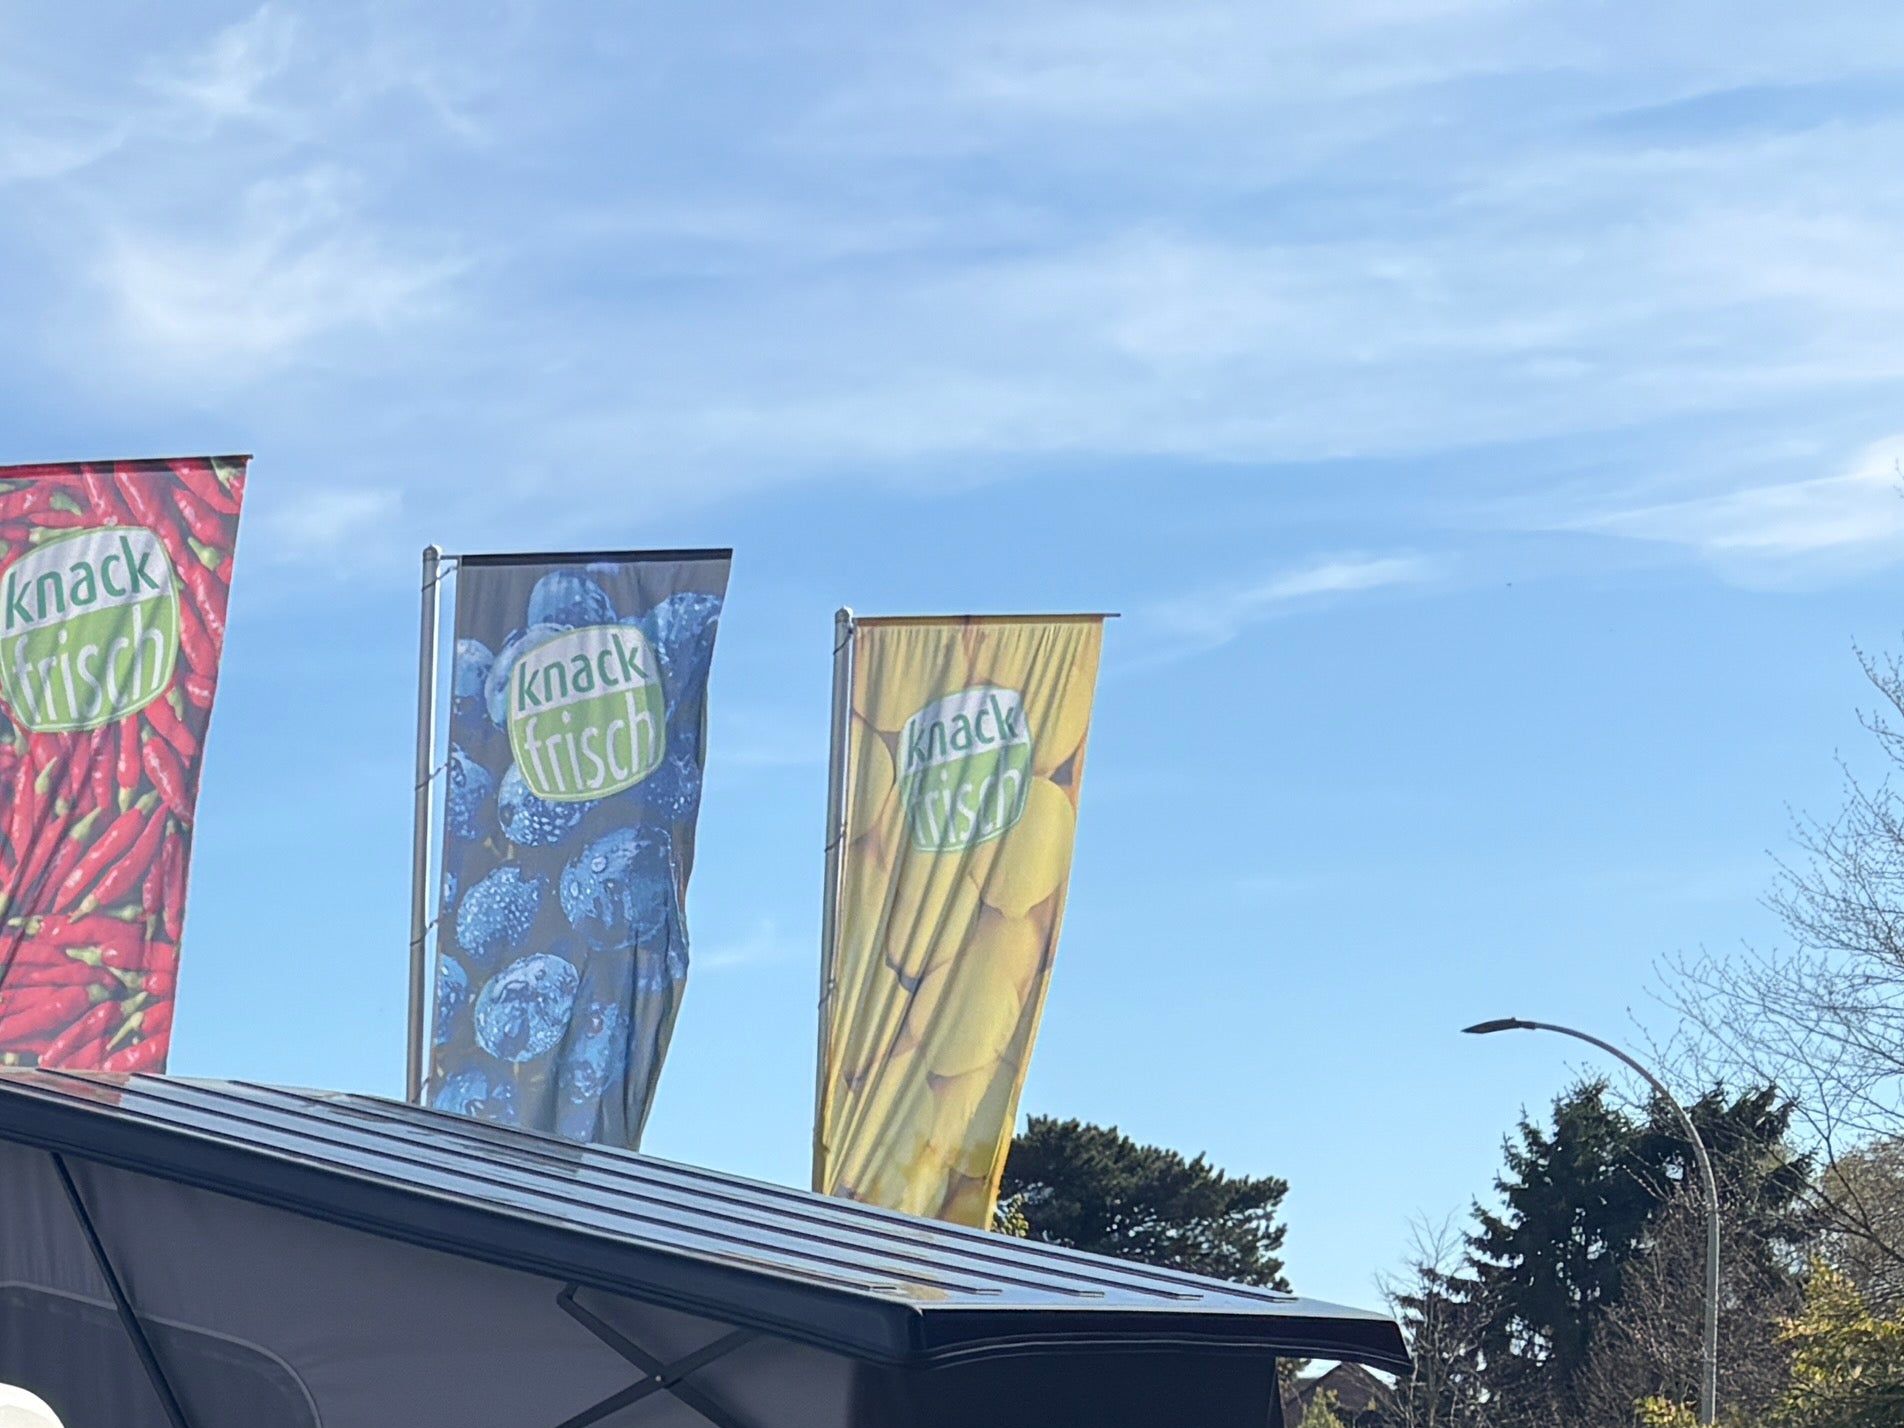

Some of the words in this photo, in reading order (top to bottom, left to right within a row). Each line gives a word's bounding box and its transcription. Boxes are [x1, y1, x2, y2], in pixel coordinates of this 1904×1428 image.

[5, 535, 160, 630] knack
[13, 603, 164, 724] frisch
[518, 633, 649, 712] knack
[524, 690, 656, 792] frisch
[907, 693, 1019, 768] knack
